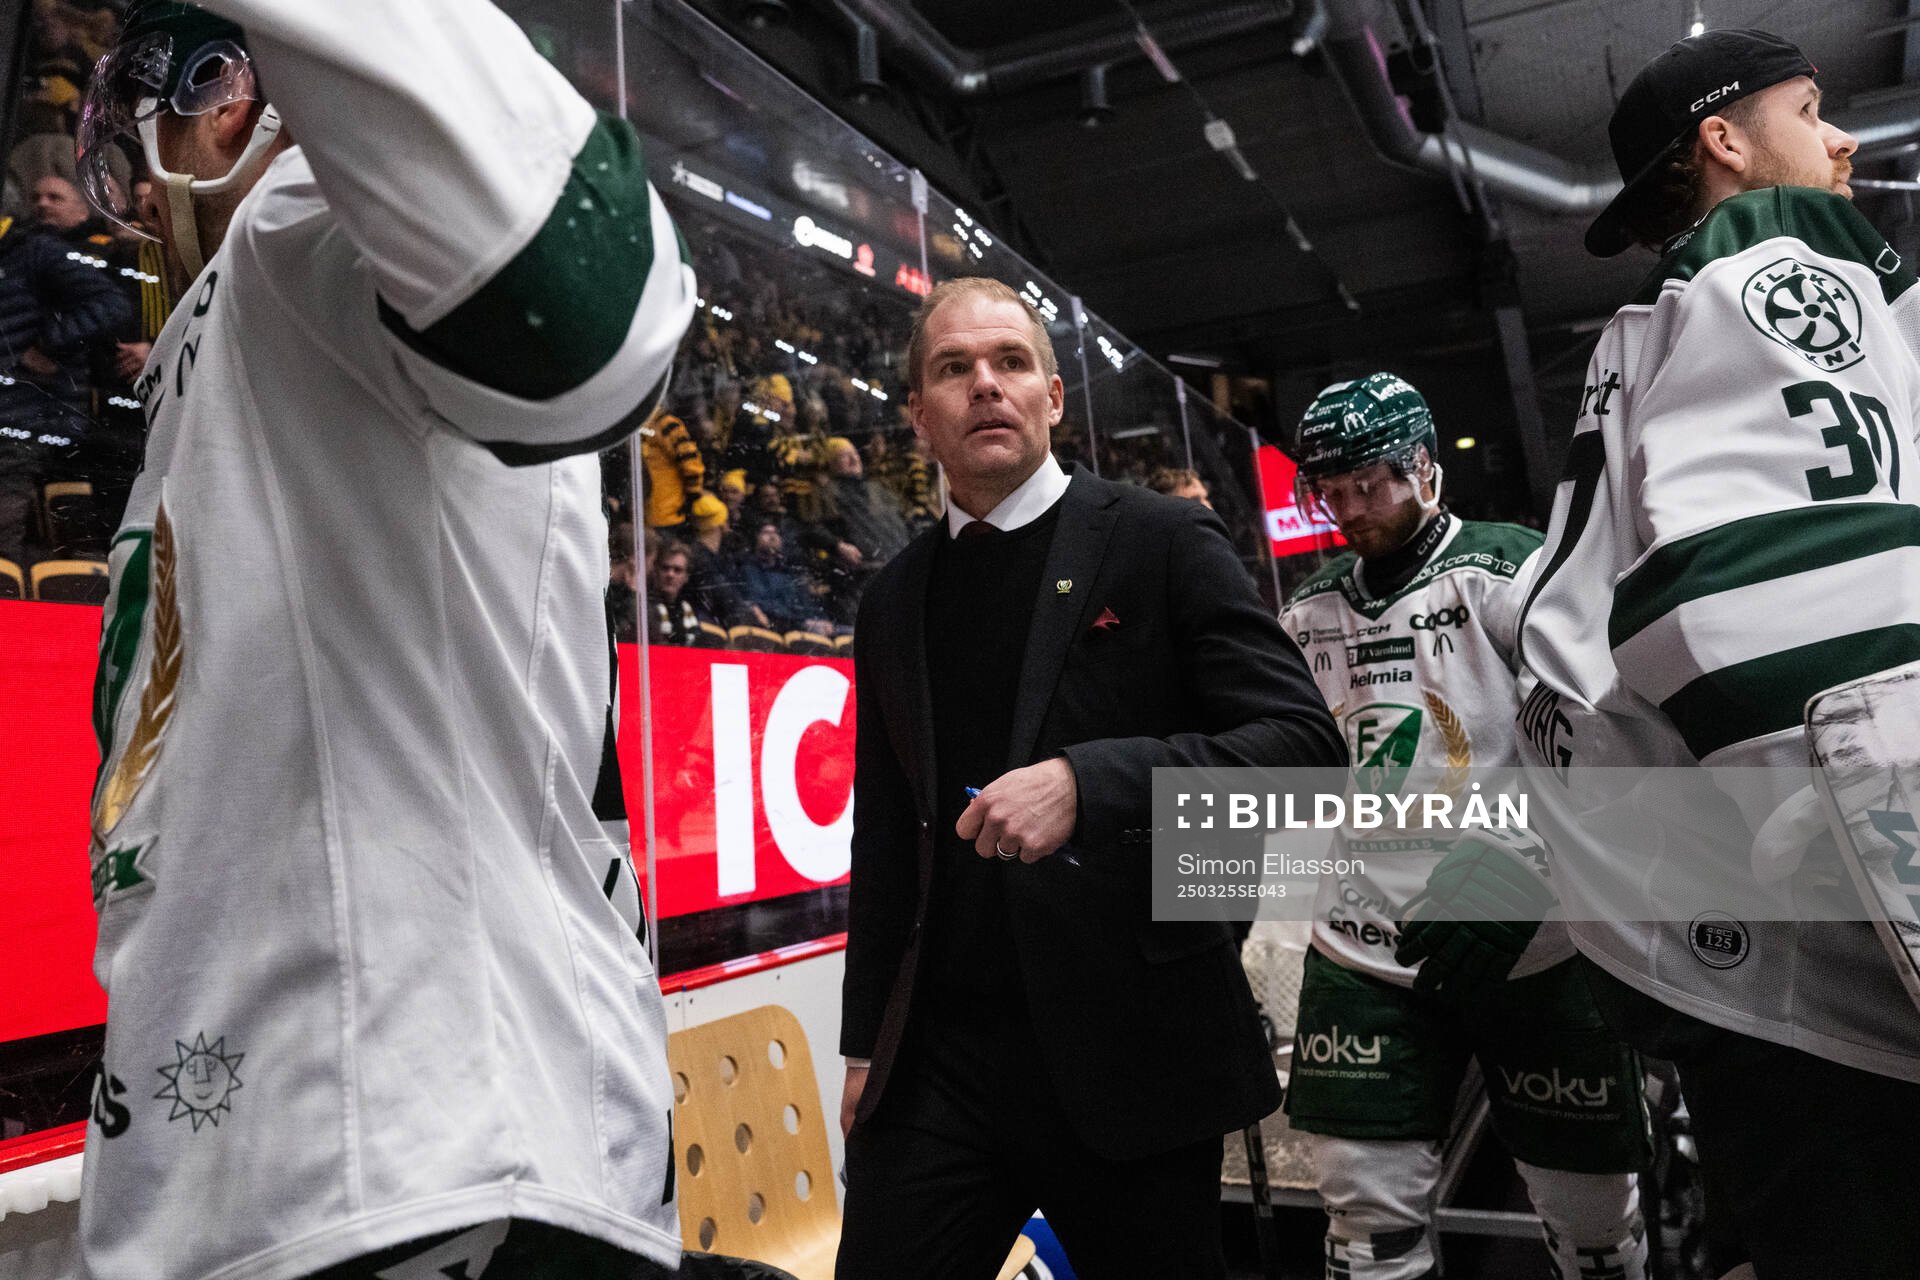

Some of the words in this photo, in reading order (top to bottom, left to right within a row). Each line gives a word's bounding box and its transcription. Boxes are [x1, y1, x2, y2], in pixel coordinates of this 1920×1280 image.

[1690, 81, 1741, 113] CCM
[1303, 421, 1337, 437] CCM
[1416, 515, 1447, 556] CCM
[1356, 623, 1392, 638] CCM
[1409, 605, 1470, 634] coop
[1350, 667, 1413, 690] Helmia
[1705, 933, 1732, 949] 125
